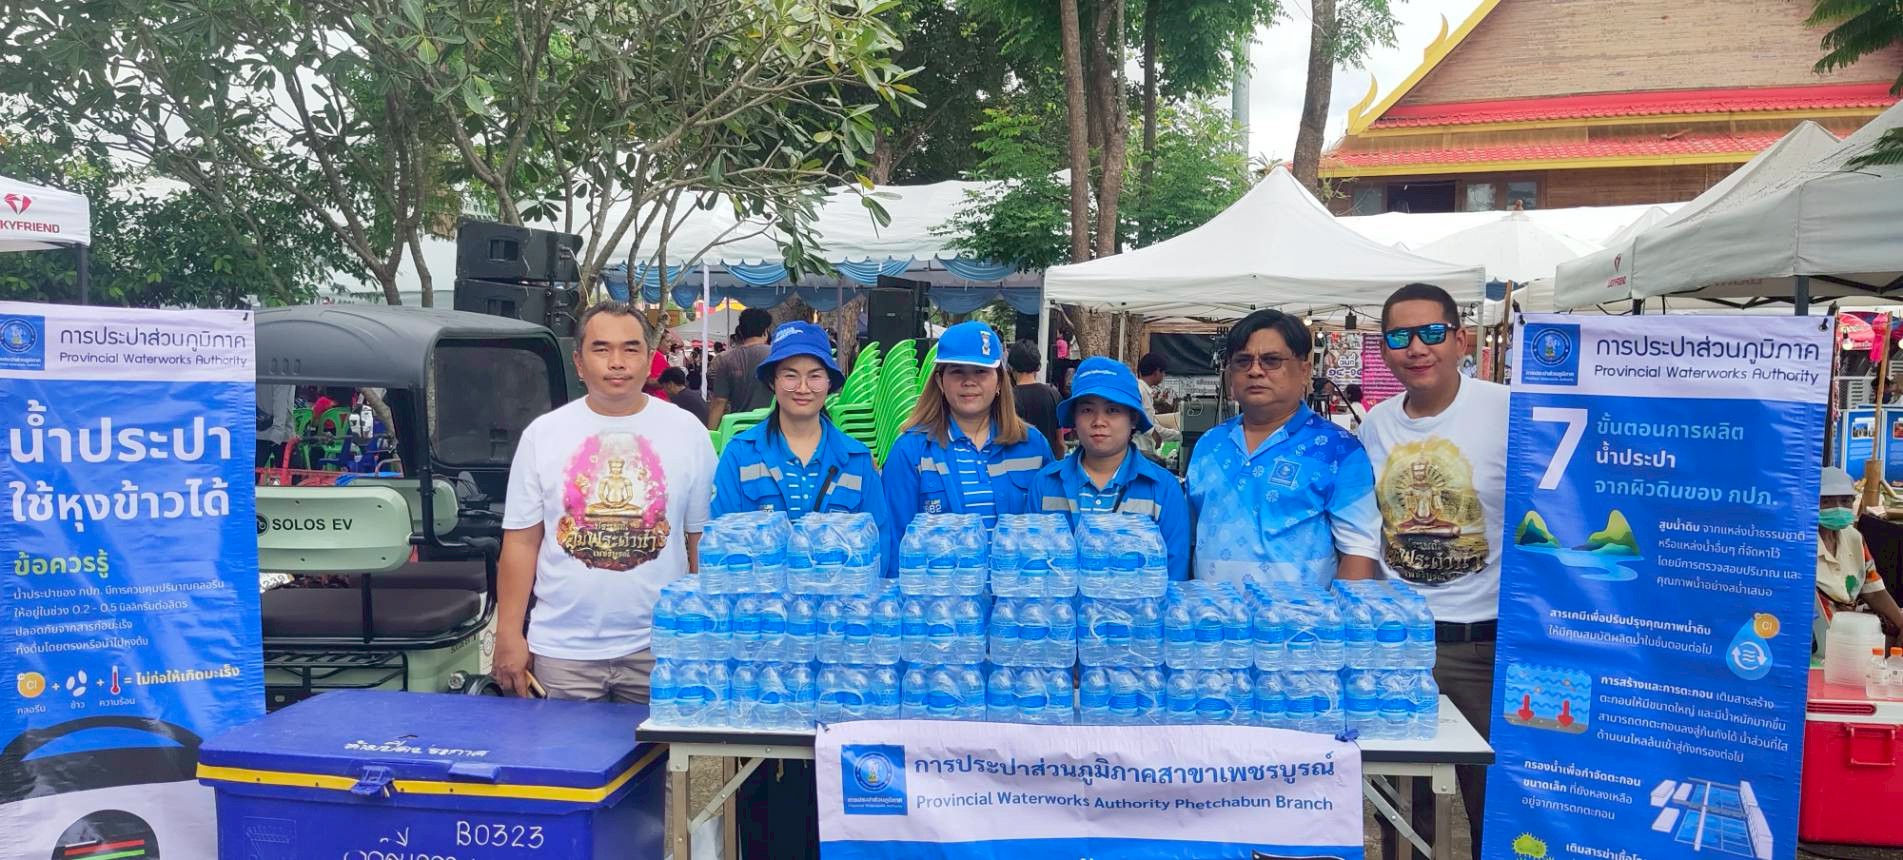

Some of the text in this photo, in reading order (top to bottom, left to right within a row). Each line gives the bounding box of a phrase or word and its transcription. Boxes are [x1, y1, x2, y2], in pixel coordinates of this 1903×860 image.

[60, 327, 246, 351] การประปาส่วนภูมิภาค
[1596, 336, 1819, 364] การประปาส่วนภูมิภาค
[60, 352, 248, 367] Provincial Waterworks Authority
[1594, 364, 1819, 385] Provincial Waterworks Authority
[10, 400, 232, 463] น้ำประปา
[1597, 412, 1744, 441] ขั้นตอนการผลิต
[1532, 406, 1588, 490] 7
[1596, 441, 1677, 469] น้ำประปา
[9, 477, 230, 533] ใช้หุงข้าวได้
[1594, 480, 1779, 506] จากผิวดินของ กปภ.
[272, 518, 353, 531] SOLOS EV
[1659, 517, 1806, 541] สูบน้ำดิบ จากแหล่งน้ำธรรมชาติ
[13, 549, 109, 579] ข้อควรรู้
[72, 604, 90, 615] 0.2
[100, 603, 117, 613] 0.5
[26, 680, 37, 690] Cl
[70, 700, 86, 710] ข้าว
[914, 752, 1335, 786] การประปาส่วนภูมิภาคสาขาเพชรบูรณ์
[1523, 778, 1567, 793] ขนาดเล็ก
[916, 792, 1334, 812] Provincial Waterworks Authority Phetchabun Branch
[456, 821, 545, 849] B0323
